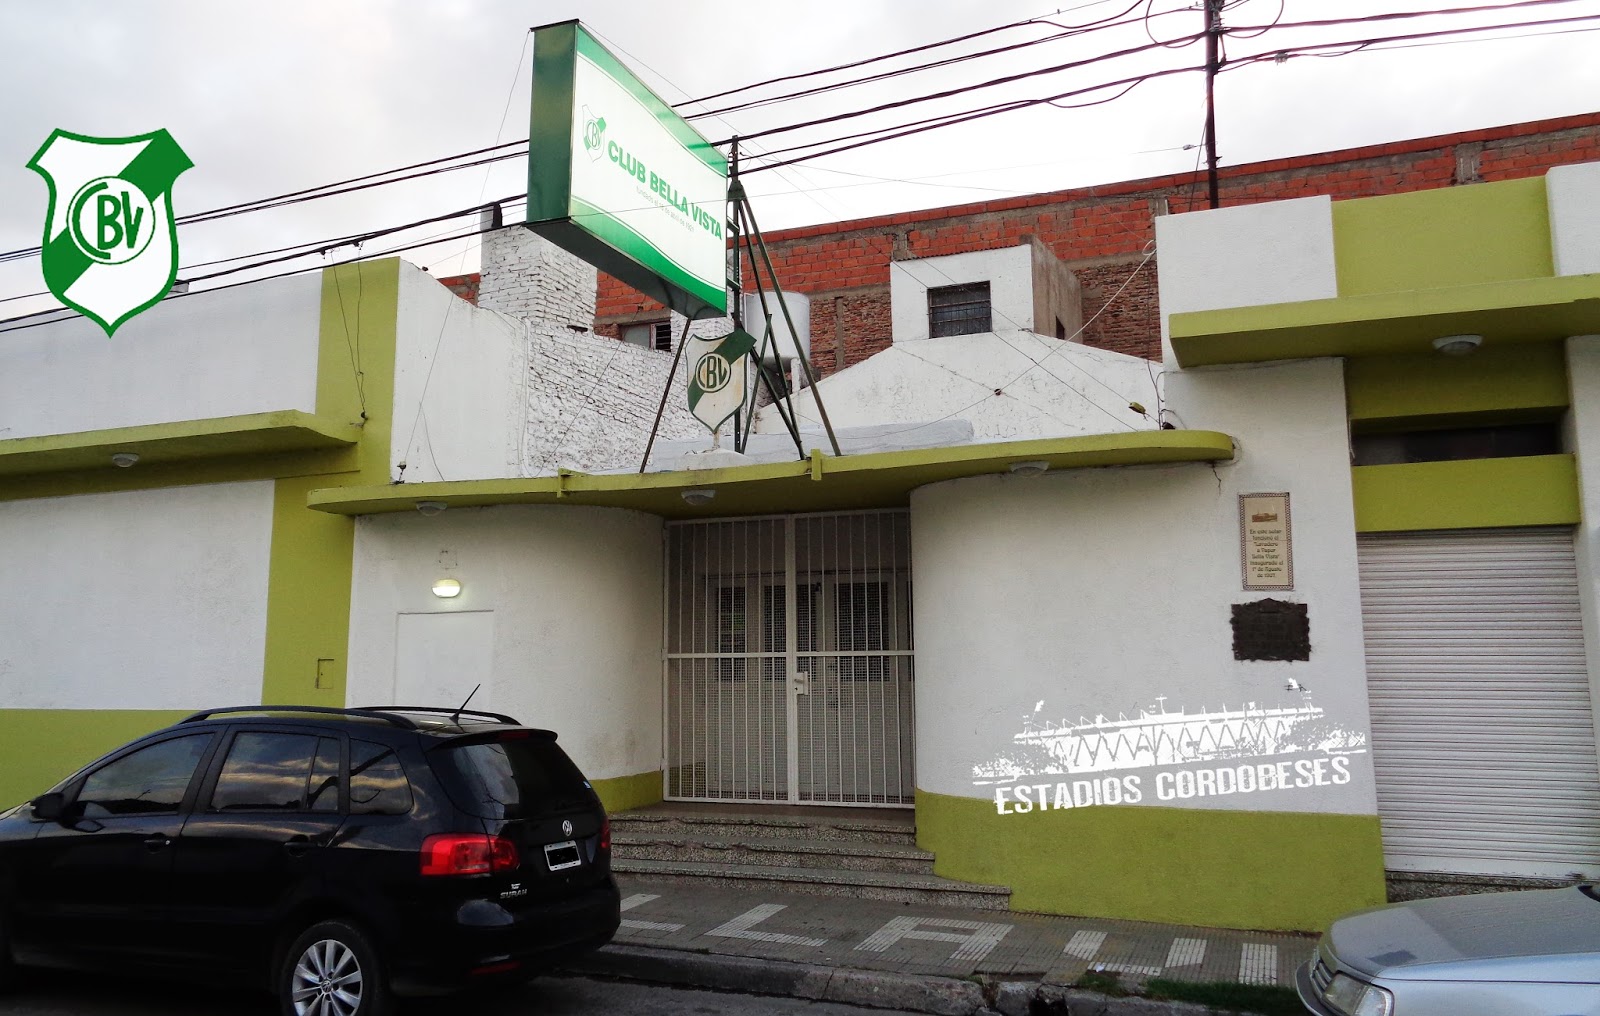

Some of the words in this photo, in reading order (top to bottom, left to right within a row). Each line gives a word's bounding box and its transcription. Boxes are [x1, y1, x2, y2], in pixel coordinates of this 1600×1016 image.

[607, 140, 646, 184] CLUB
[650, 170, 689, 217] BELLA
[691, 202, 723, 241] VISTA
